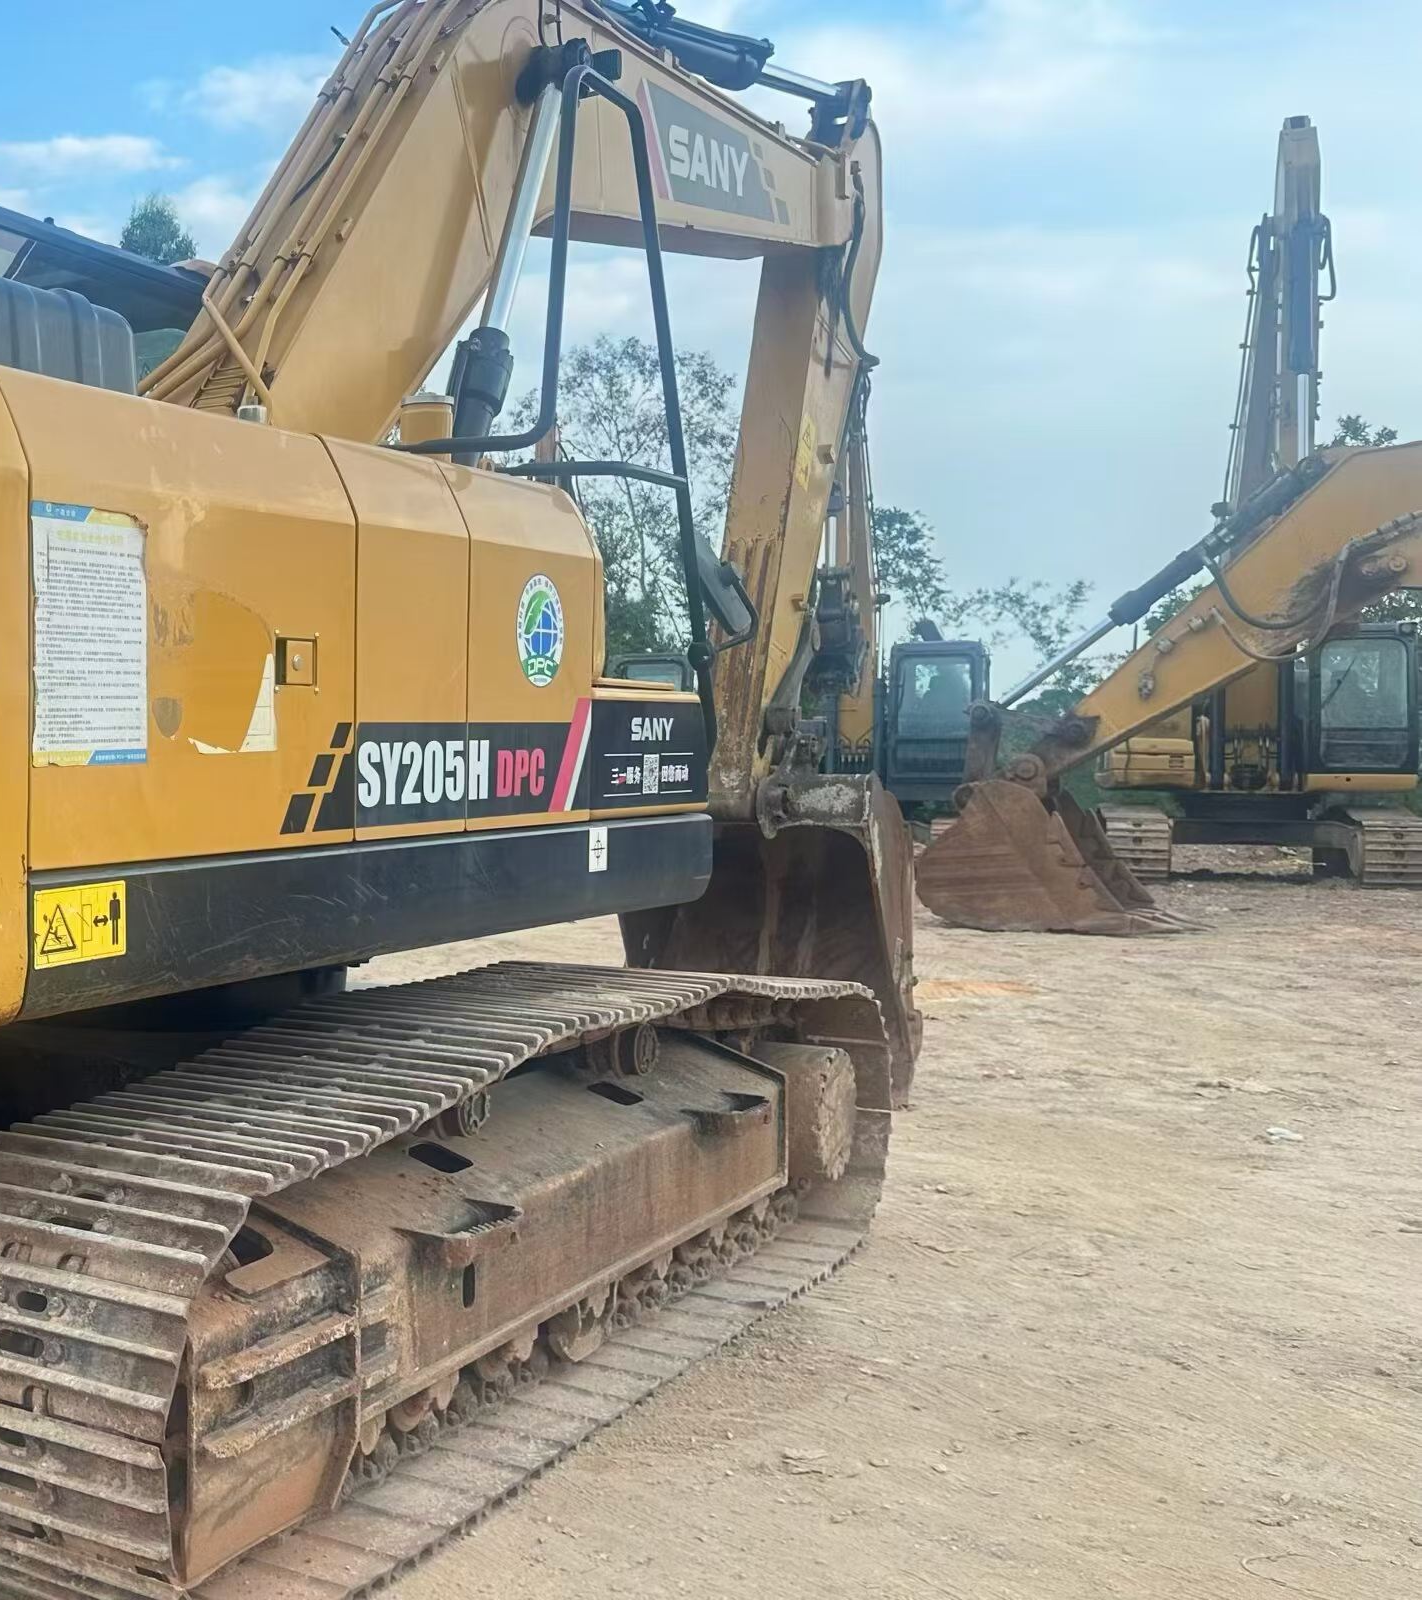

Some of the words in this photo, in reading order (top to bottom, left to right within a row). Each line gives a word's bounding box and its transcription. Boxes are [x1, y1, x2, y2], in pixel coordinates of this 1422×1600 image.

[669, 125, 749, 197] SANY
[527, 657, 554, 676] DPC
[631, 717, 674, 741] SANY
[358, 740, 490, 808] SY205H
[496, 748, 545, 798] DPC
